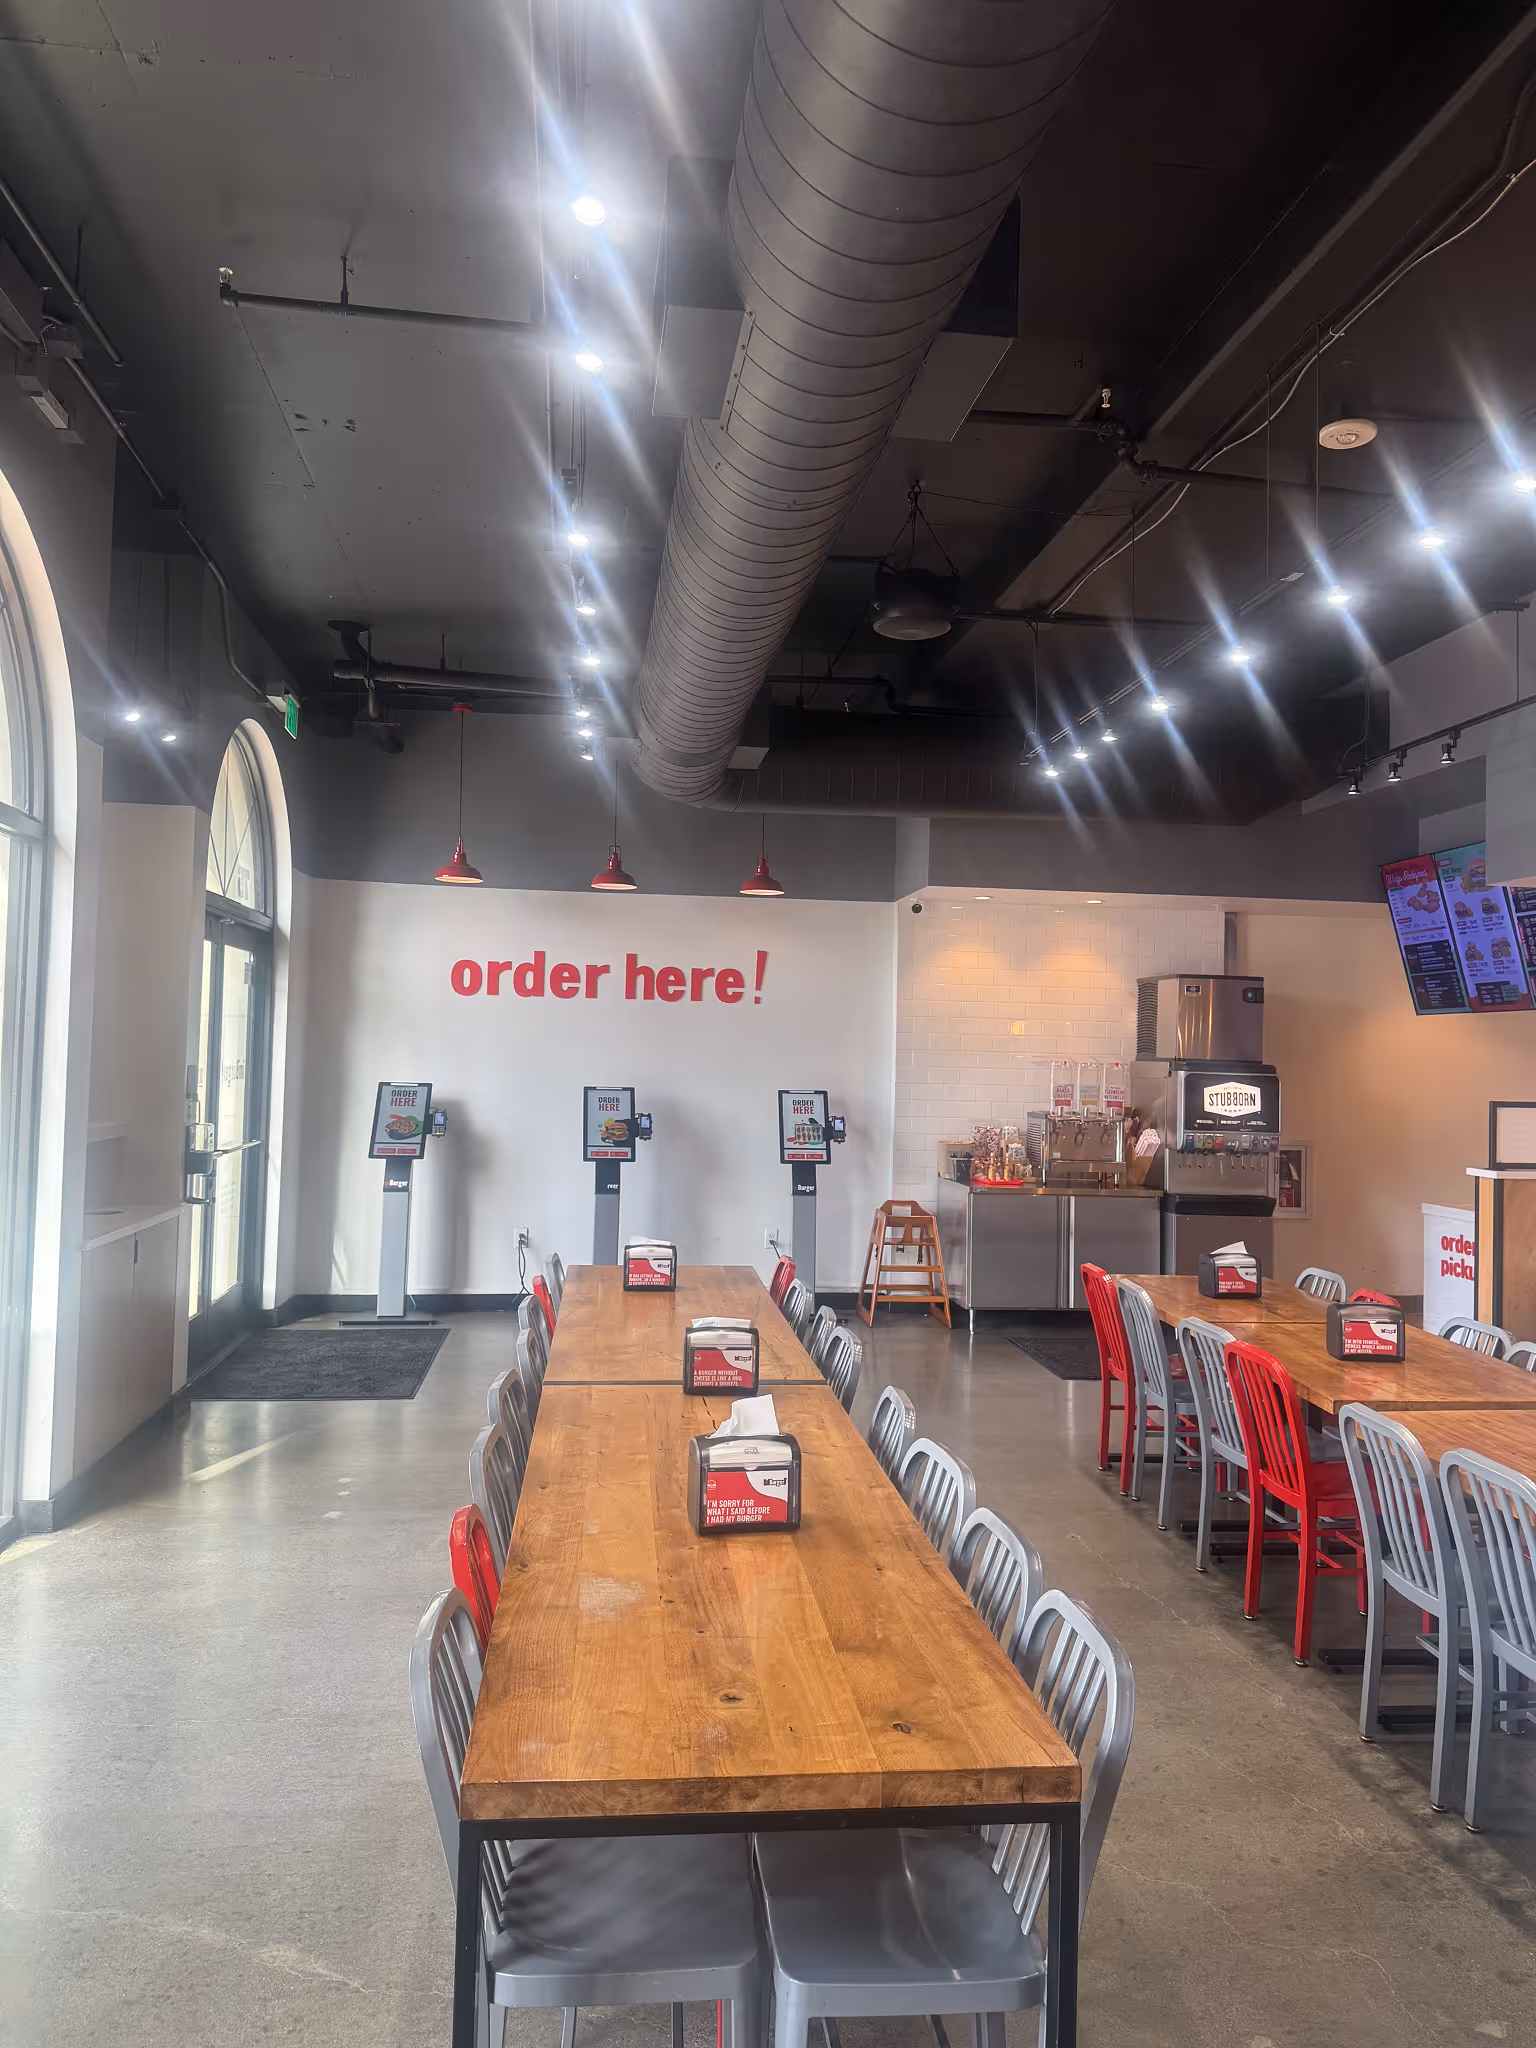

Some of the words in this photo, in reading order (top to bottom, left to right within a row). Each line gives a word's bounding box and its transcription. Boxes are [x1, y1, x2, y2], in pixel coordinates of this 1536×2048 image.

[450, 950, 610, 999] order
[624, 950, 768, 1005] here!
[391, 1089, 417, 1097] ORDER
[390, 1097, 417, 1107] HERE
[1208, 1092, 1256, 1106] STUBBORN
[598, 1104, 620, 1112] HERE
[793, 1106, 814, 1114] HERE
[707, 1500, 717, 1508] I'M
[707, 1508, 726, 1516] WHAT
